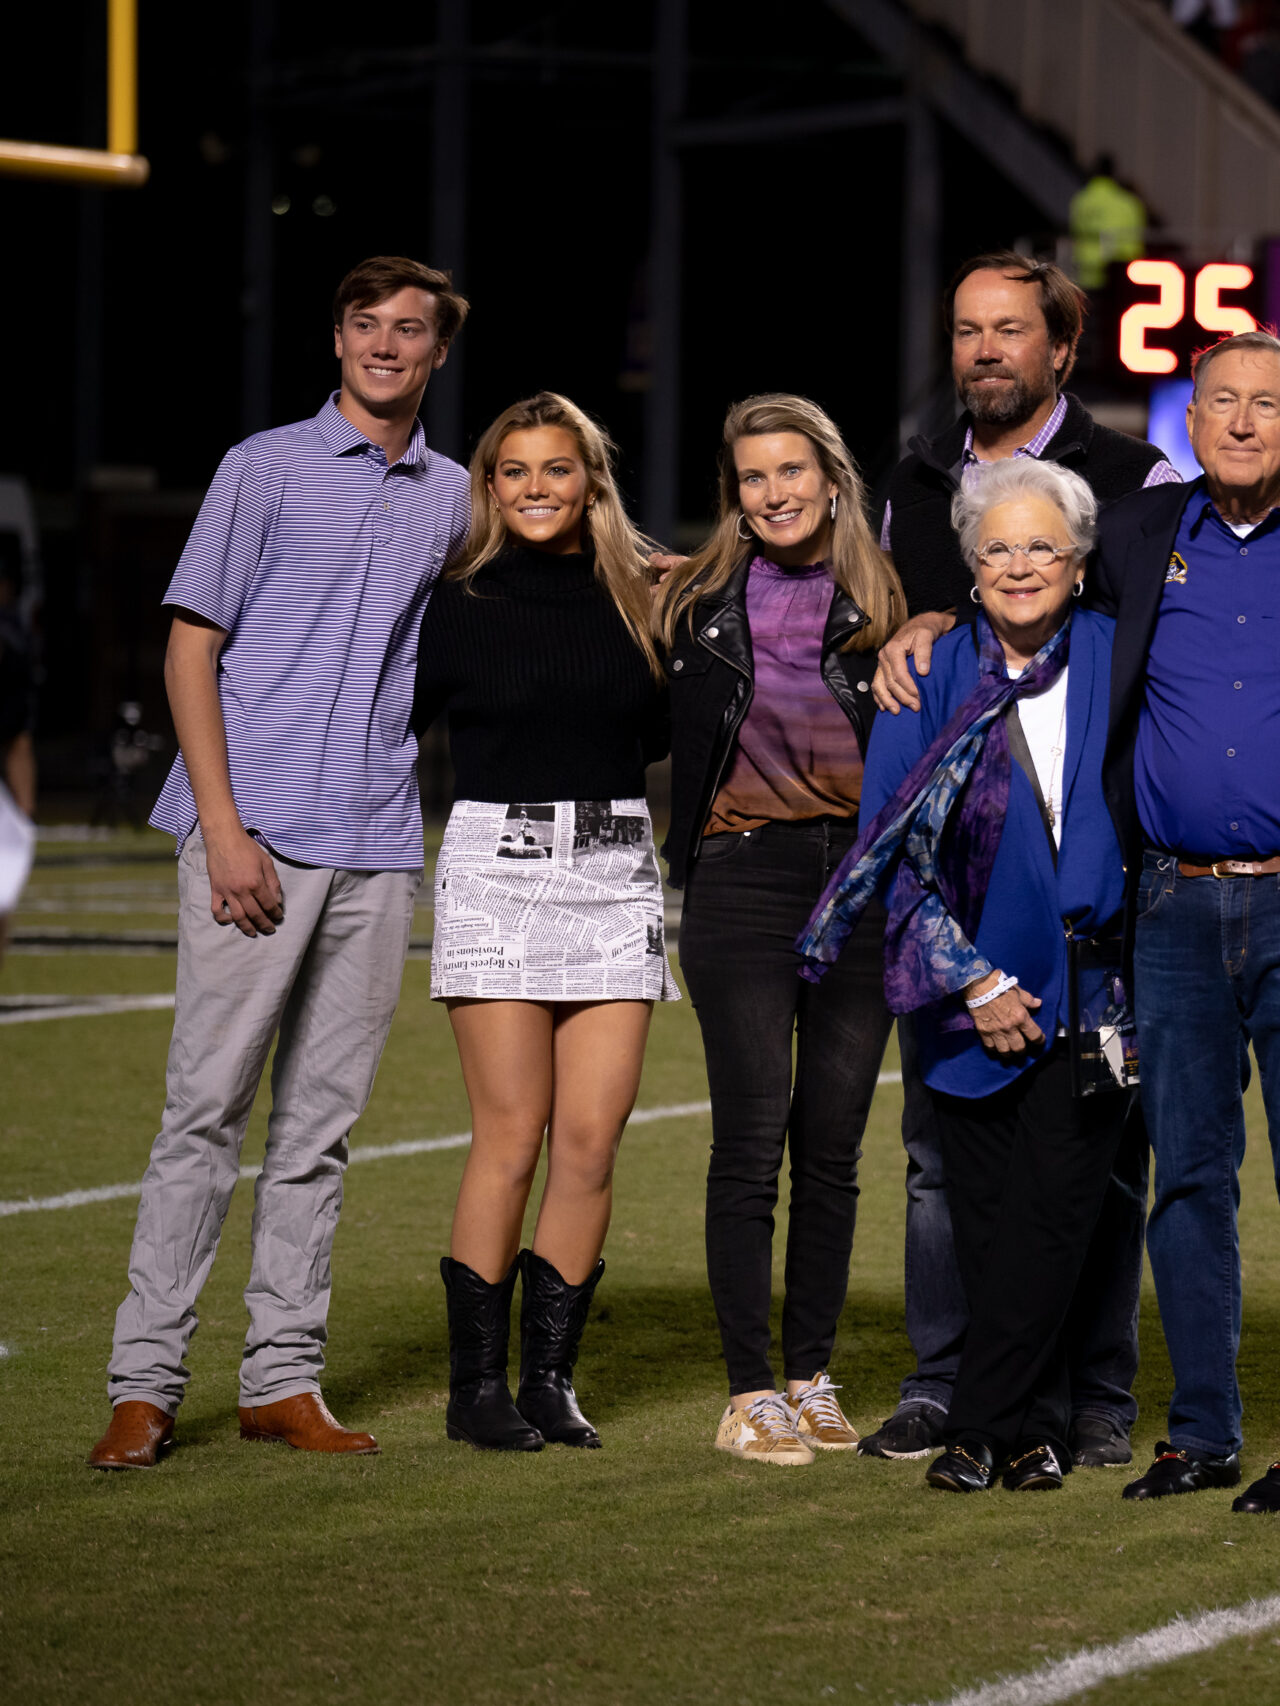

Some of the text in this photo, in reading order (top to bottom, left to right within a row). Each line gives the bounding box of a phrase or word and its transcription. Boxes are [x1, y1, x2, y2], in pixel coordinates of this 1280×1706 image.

[1120, 260, 1257, 373] 25
[447, 946, 504, 958] Provisions in
[471, 957, 505, 970] Rejects
[508, 958, 520, 969] US
